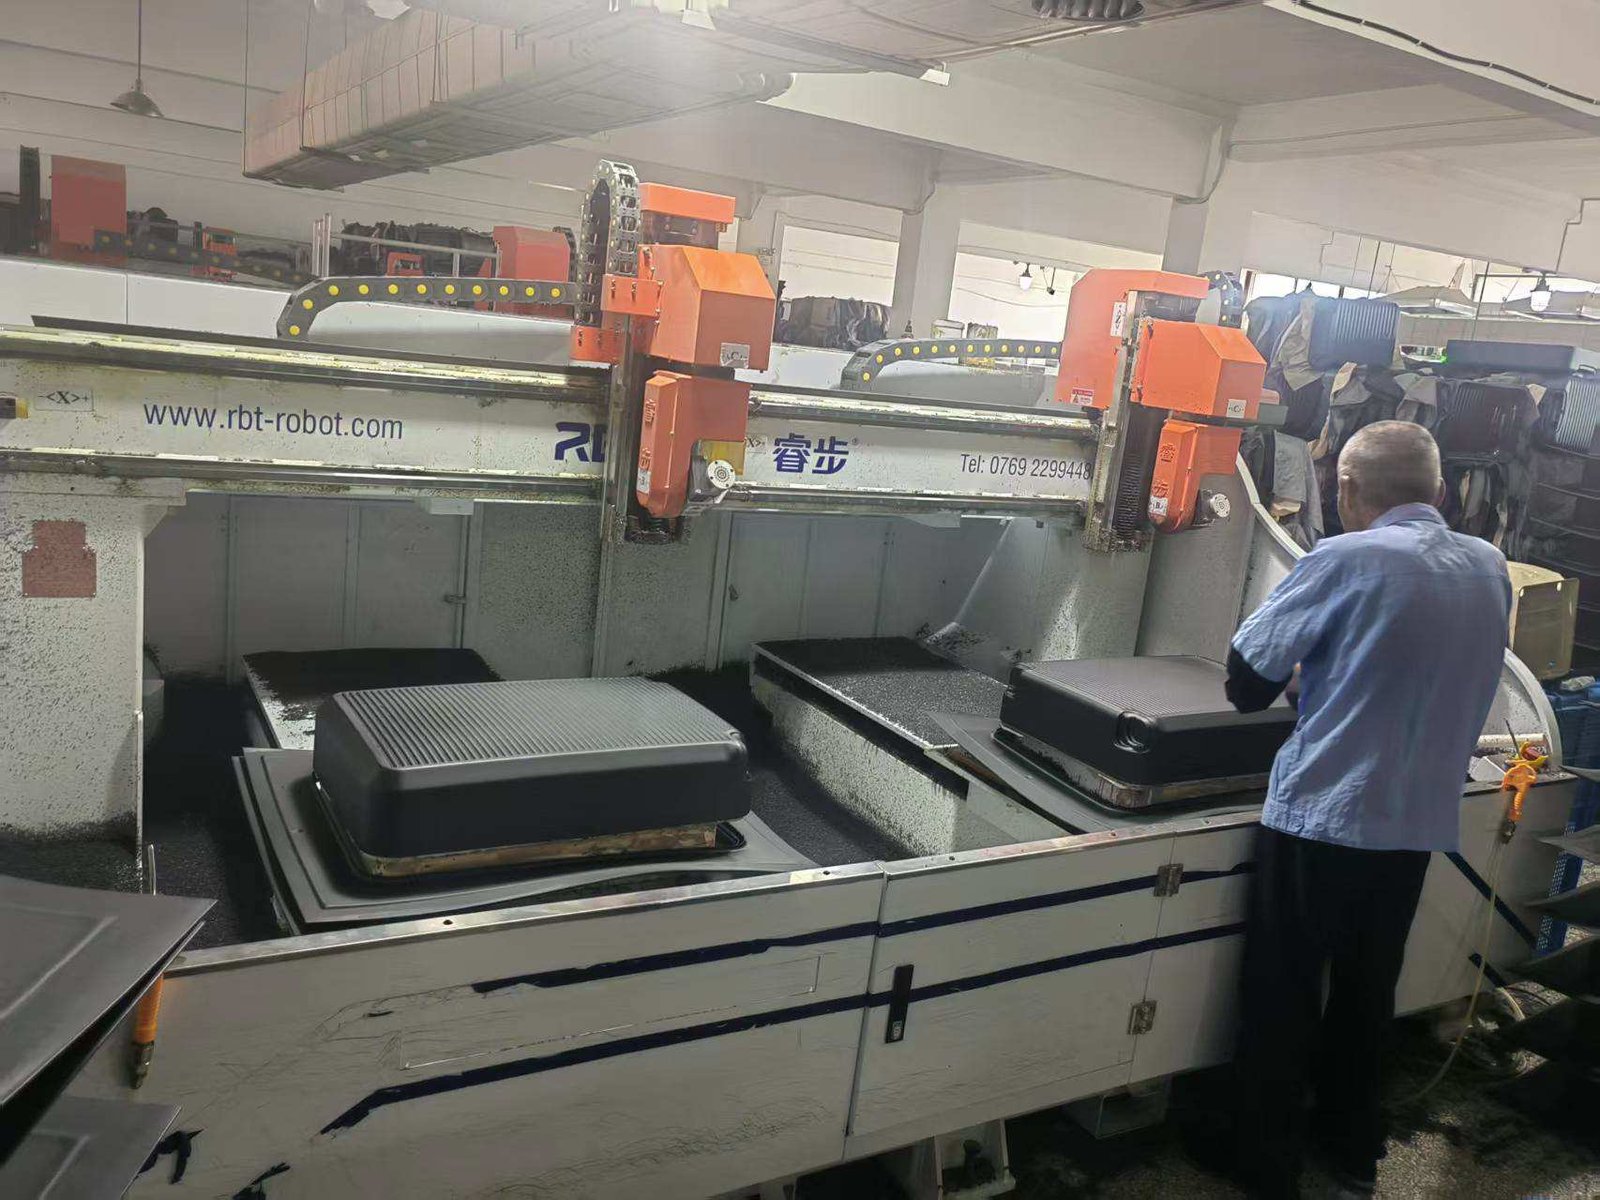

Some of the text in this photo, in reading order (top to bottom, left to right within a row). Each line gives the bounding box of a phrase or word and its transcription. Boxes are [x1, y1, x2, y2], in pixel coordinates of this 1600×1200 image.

[143, 403, 403, 440] www.rbt-robot.com
[772, 432, 850, 475] 睿步
[960, 453, 1094, 481] Tel: 0769 2299448
